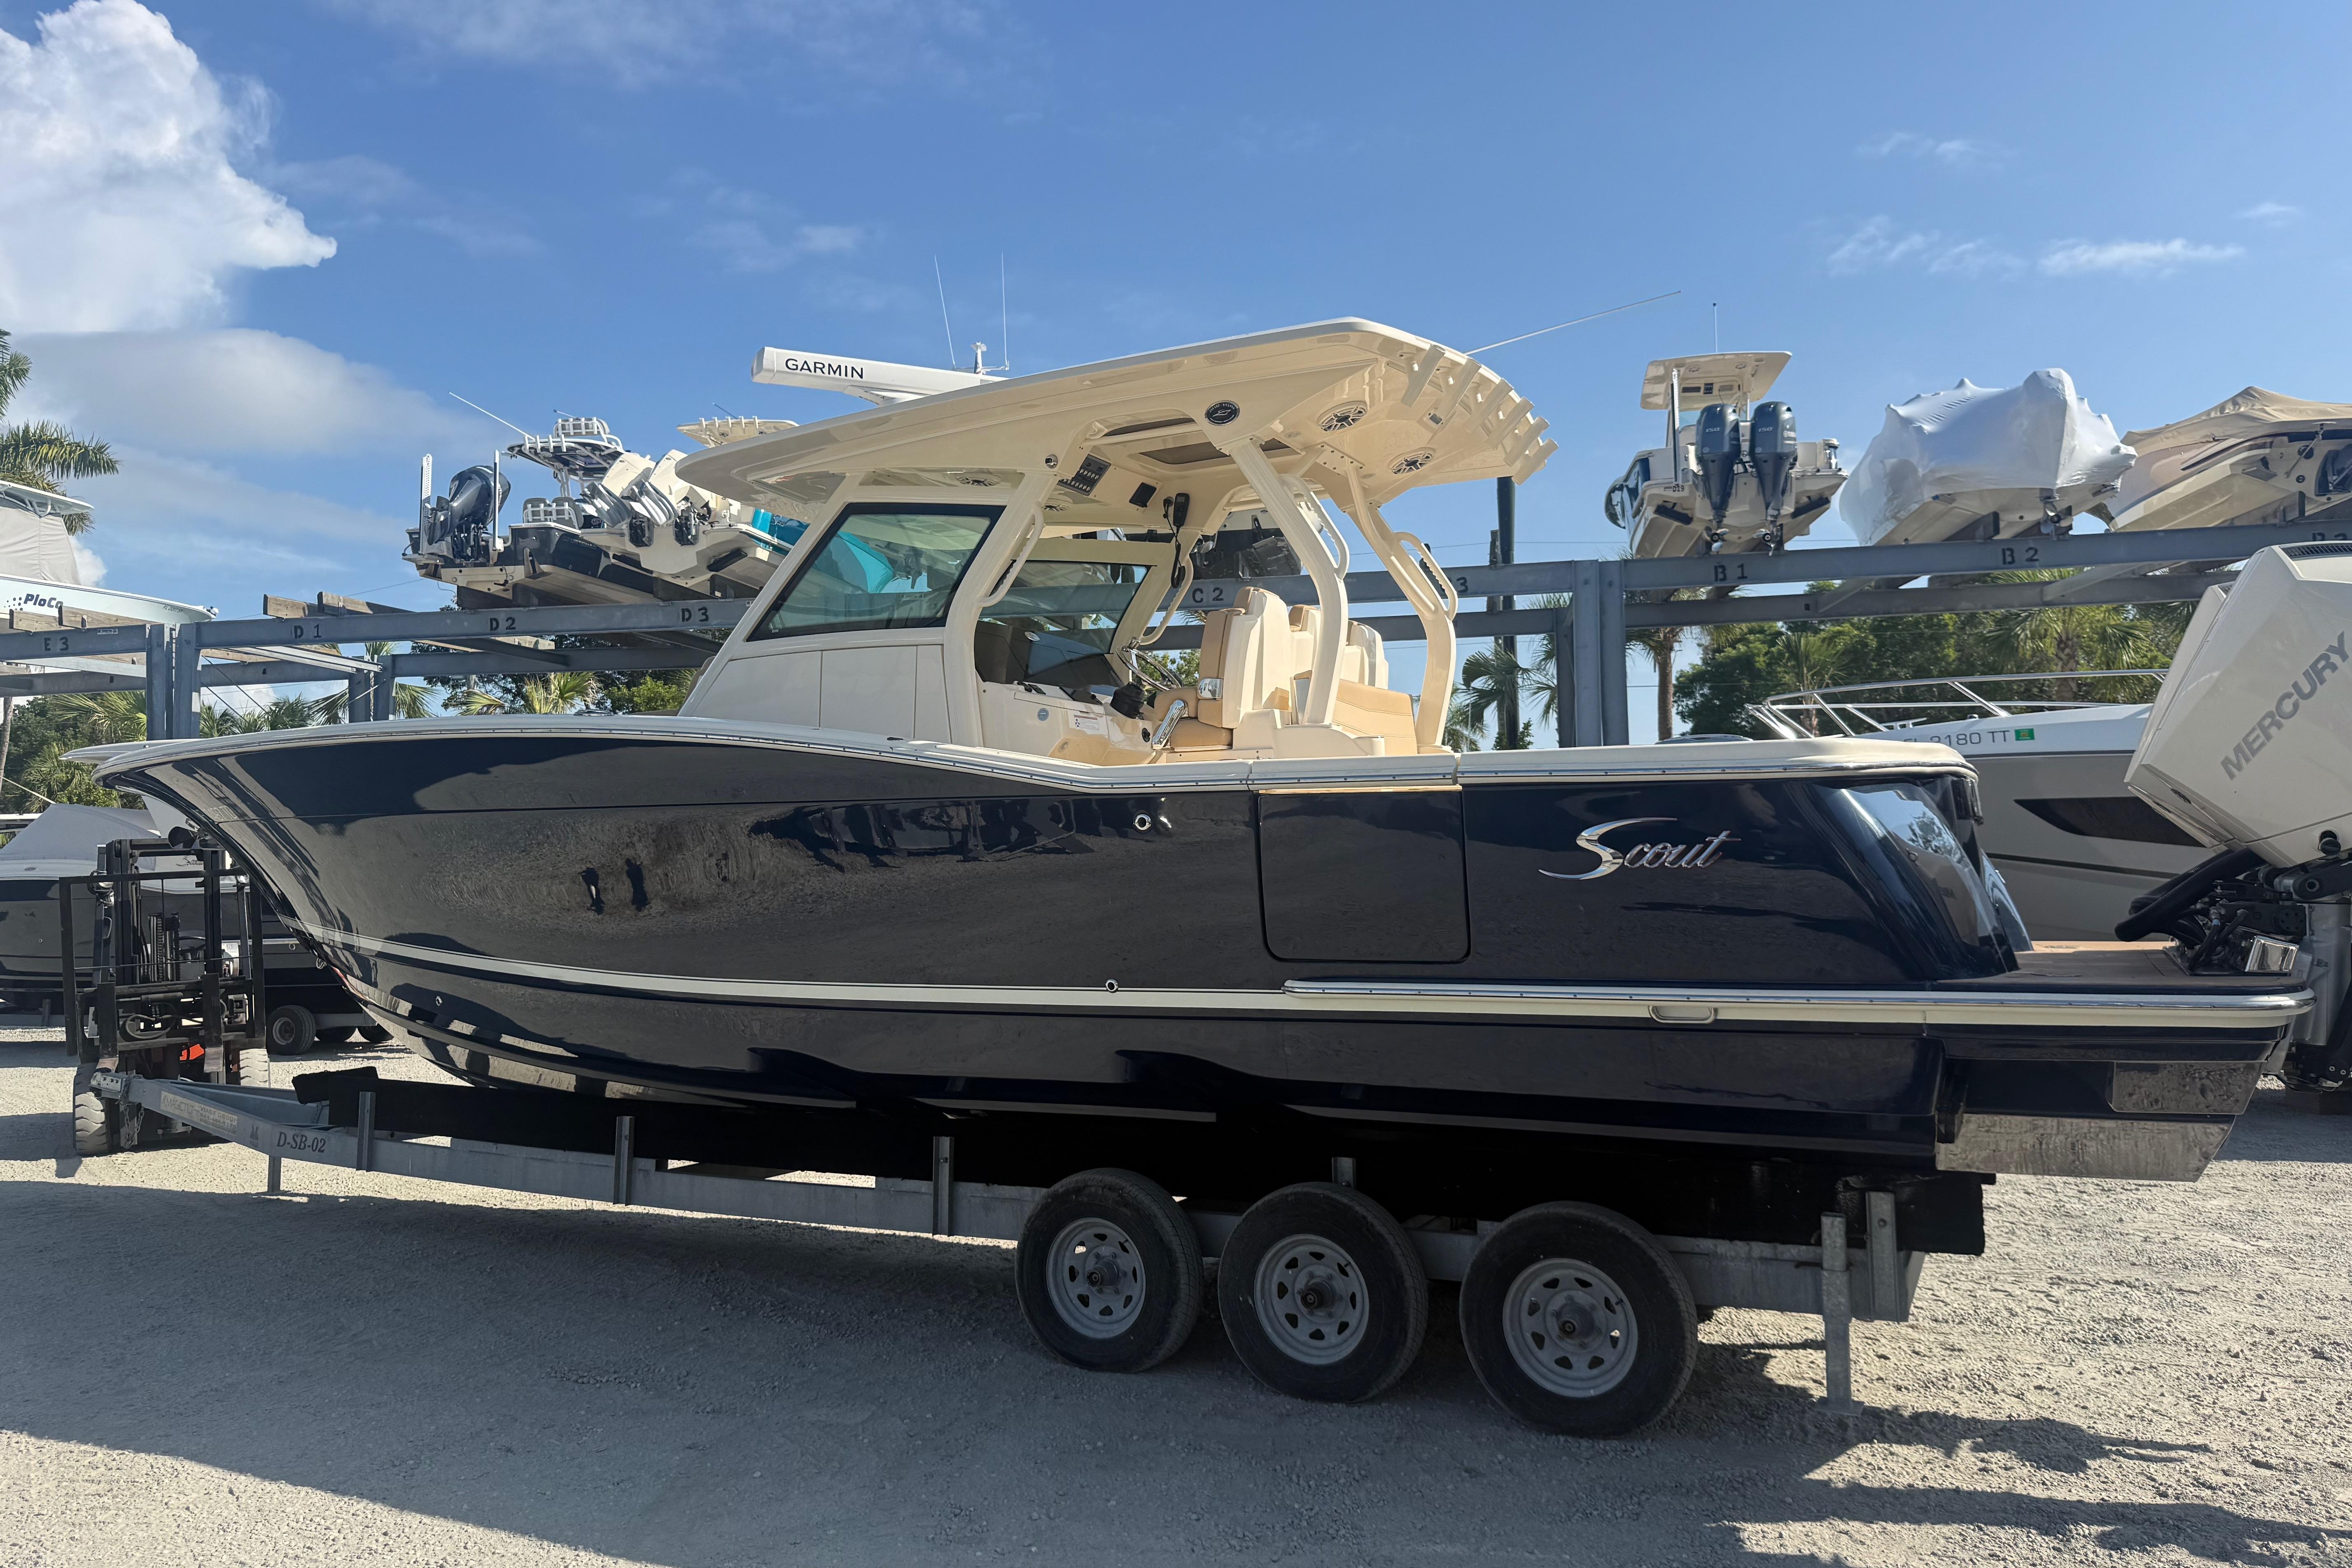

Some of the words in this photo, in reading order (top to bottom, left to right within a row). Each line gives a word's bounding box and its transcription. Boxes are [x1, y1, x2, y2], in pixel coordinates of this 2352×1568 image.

[785, 358, 863, 379] GARMIN
[2002, 548, 2015, 565] B
[2025, 547, 2039, 562] 2
[1714, 565, 1727, 582] B
[1737, 563, 1748, 579] 1
[1192, 588, 1204, 603] C
[1212, 587, 1224, 601] 2
[681, 608, 692, 622] D
[698, 607, 709, 622] 3
[294, 625, 304, 639] D
[314, 623, 322, 638] 1
[490, 618, 499, 631] D
[506, 617, 516, 630] 2
[44, 637, 51, 651] E
[60, 637, 69, 651] 3
[2221, 631, 2350, 780] MERCURY
[1987, 730, 2010, 742] TT
[1538, 817, 1741, 880] Scout
[276, 1132, 326, 1153] D-SB-02
